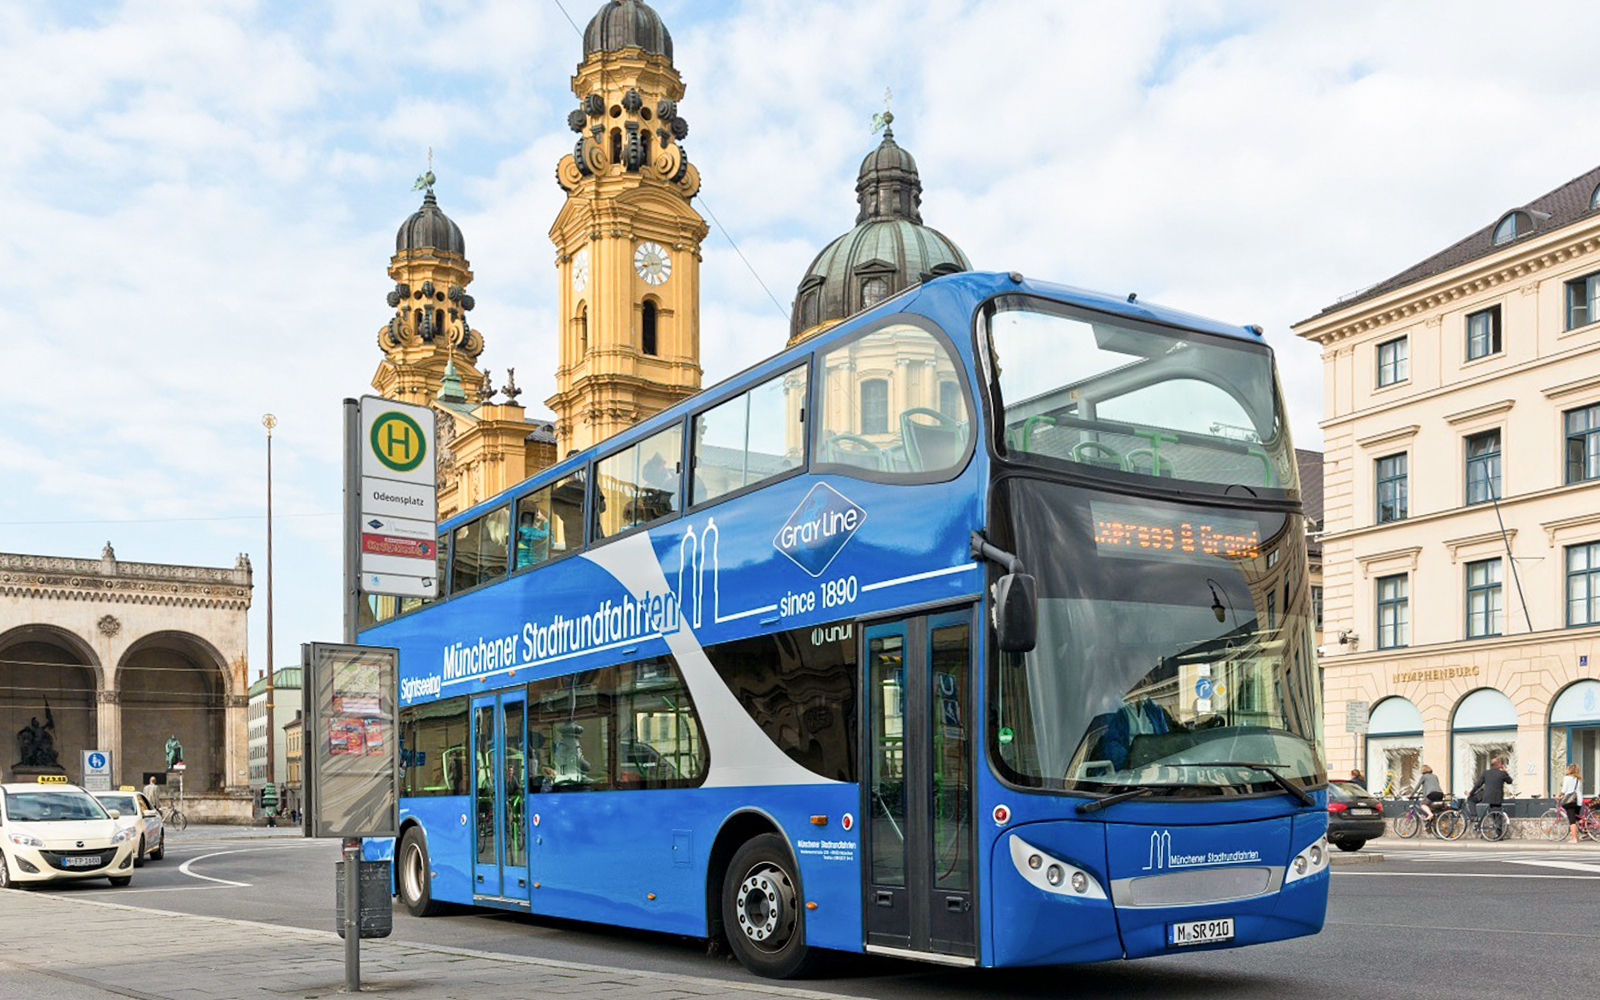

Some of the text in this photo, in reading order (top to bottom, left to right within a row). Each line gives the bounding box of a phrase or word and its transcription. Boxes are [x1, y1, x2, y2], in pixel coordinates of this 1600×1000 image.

[387, 423, 410, 460] H
[373, 492, 424, 506] Odeonsplatz
[781, 509, 857, 549] Gray Line
[780, 575, 858, 618] since 1890
[443, 590, 677, 680] Münchener Stadtrundfahrten
[401, 674, 441, 703] Sightseeing
[1392, 666, 1479, 683] NYMPHENBURG
[1171, 851, 1259, 864] Münchener Stadtrundfahrten
[1178, 921, 1229, 940] M SR 910
